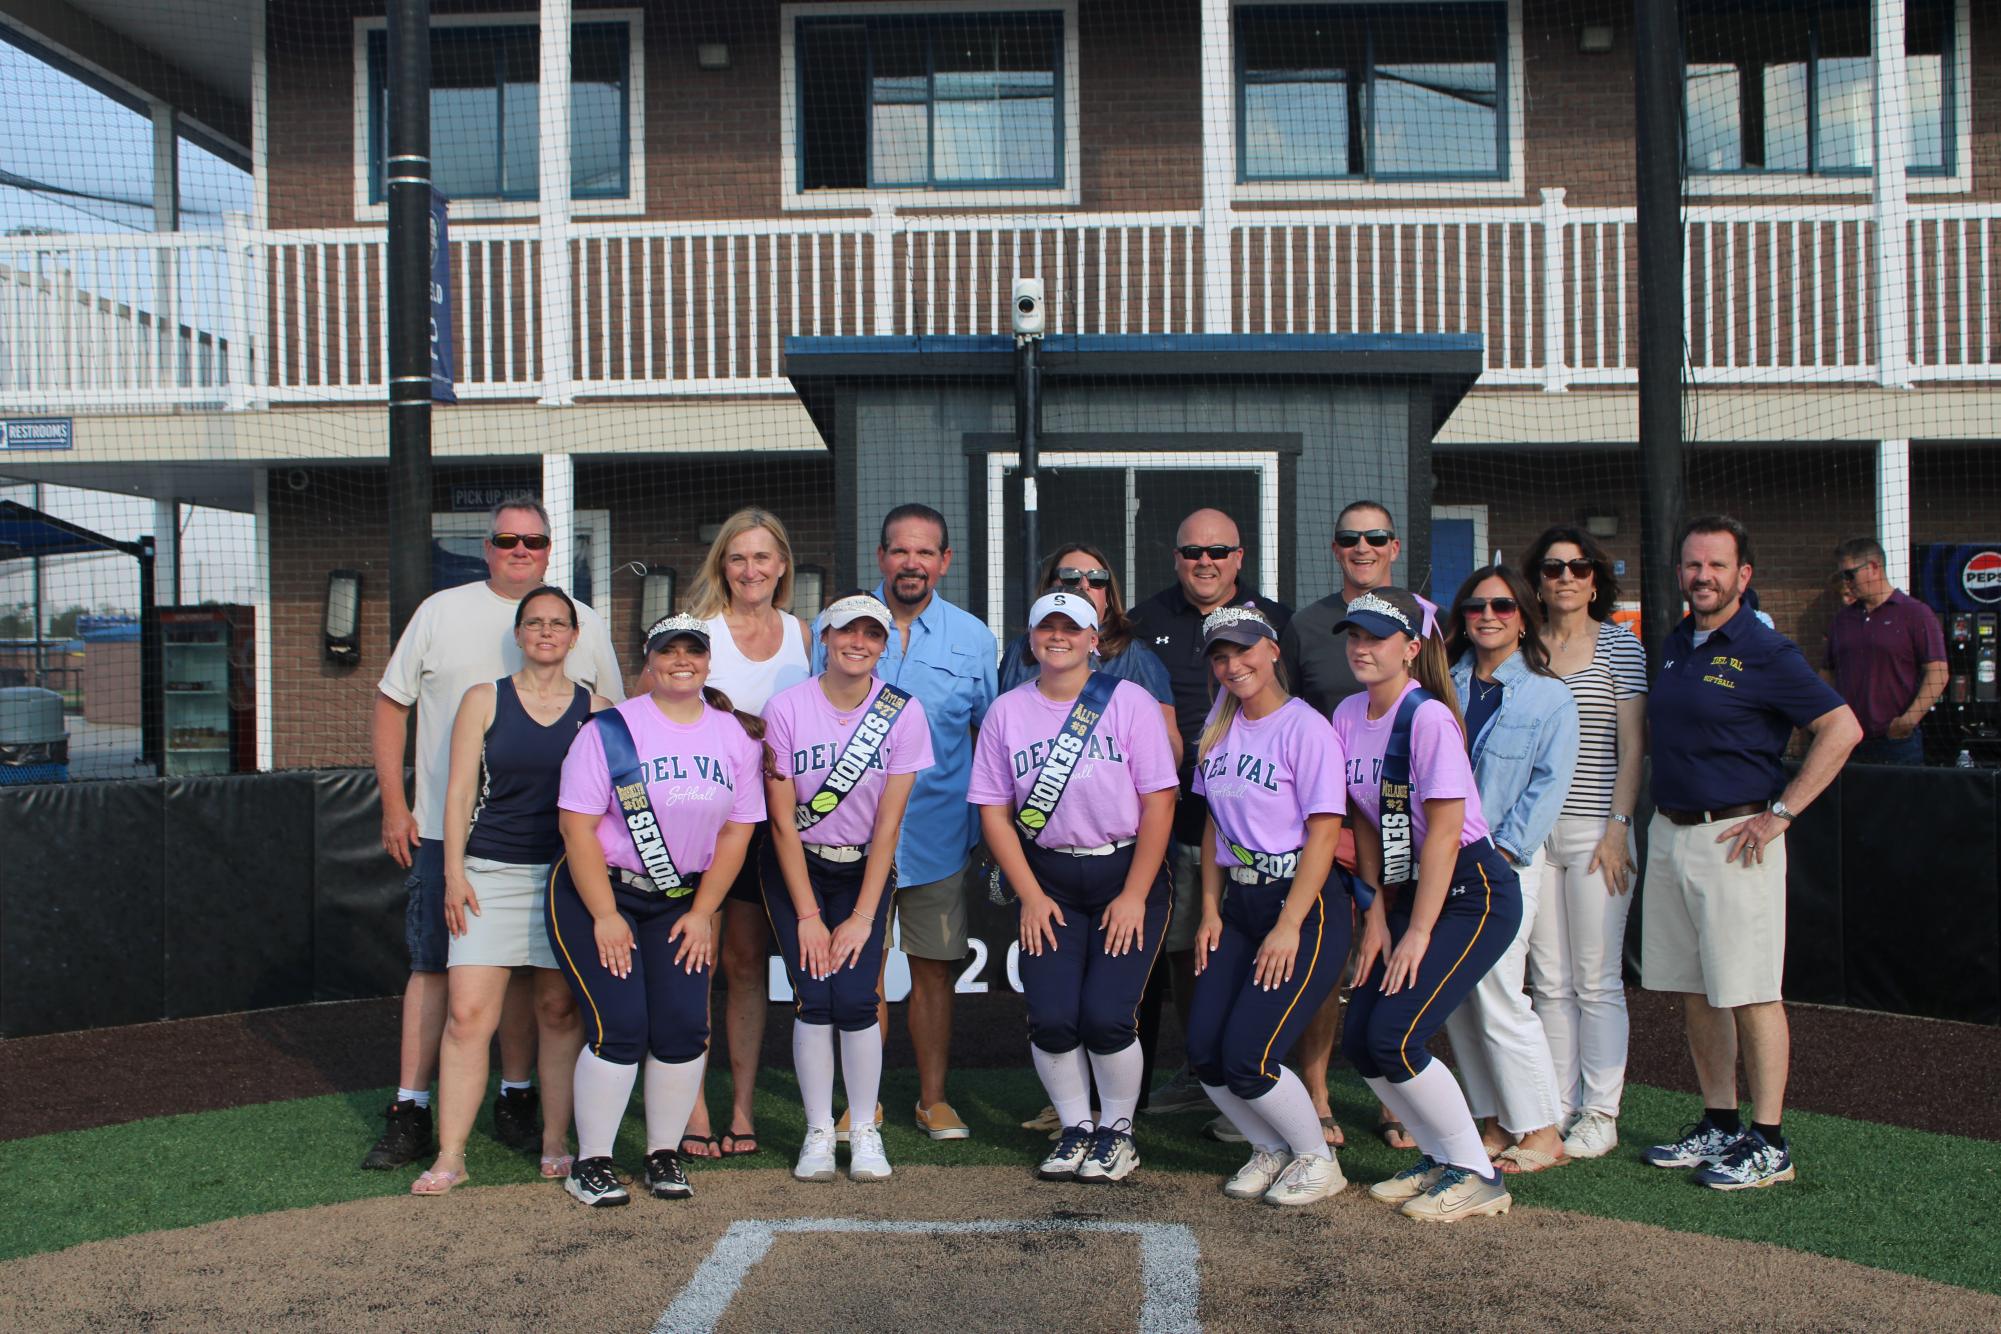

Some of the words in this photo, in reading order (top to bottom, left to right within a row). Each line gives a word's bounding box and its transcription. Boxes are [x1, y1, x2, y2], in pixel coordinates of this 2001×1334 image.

[9, 424, 67, 438] RESTROOMS
[456, 489, 483, 504] PICK
[1054, 595, 1066, 606] S
[1730, 657, 1743, 671] VAL
[874, 700, 897, 719] #27
[1072, 703, 1099, 725] ALLY
[826, 712, 890, 793] SENIOR
[693, 755, 733, 792] VAL
[1026, 733, 1084, 812] SENIOR
[1236, 754, 1278, 791] VAL
[666, 786, 717, 807] Softball
[627, 810, 682, 891] SENIOR
[1382, 813, 1411, 886] SENIOR
[1254, 851, 1303, 878] 202
